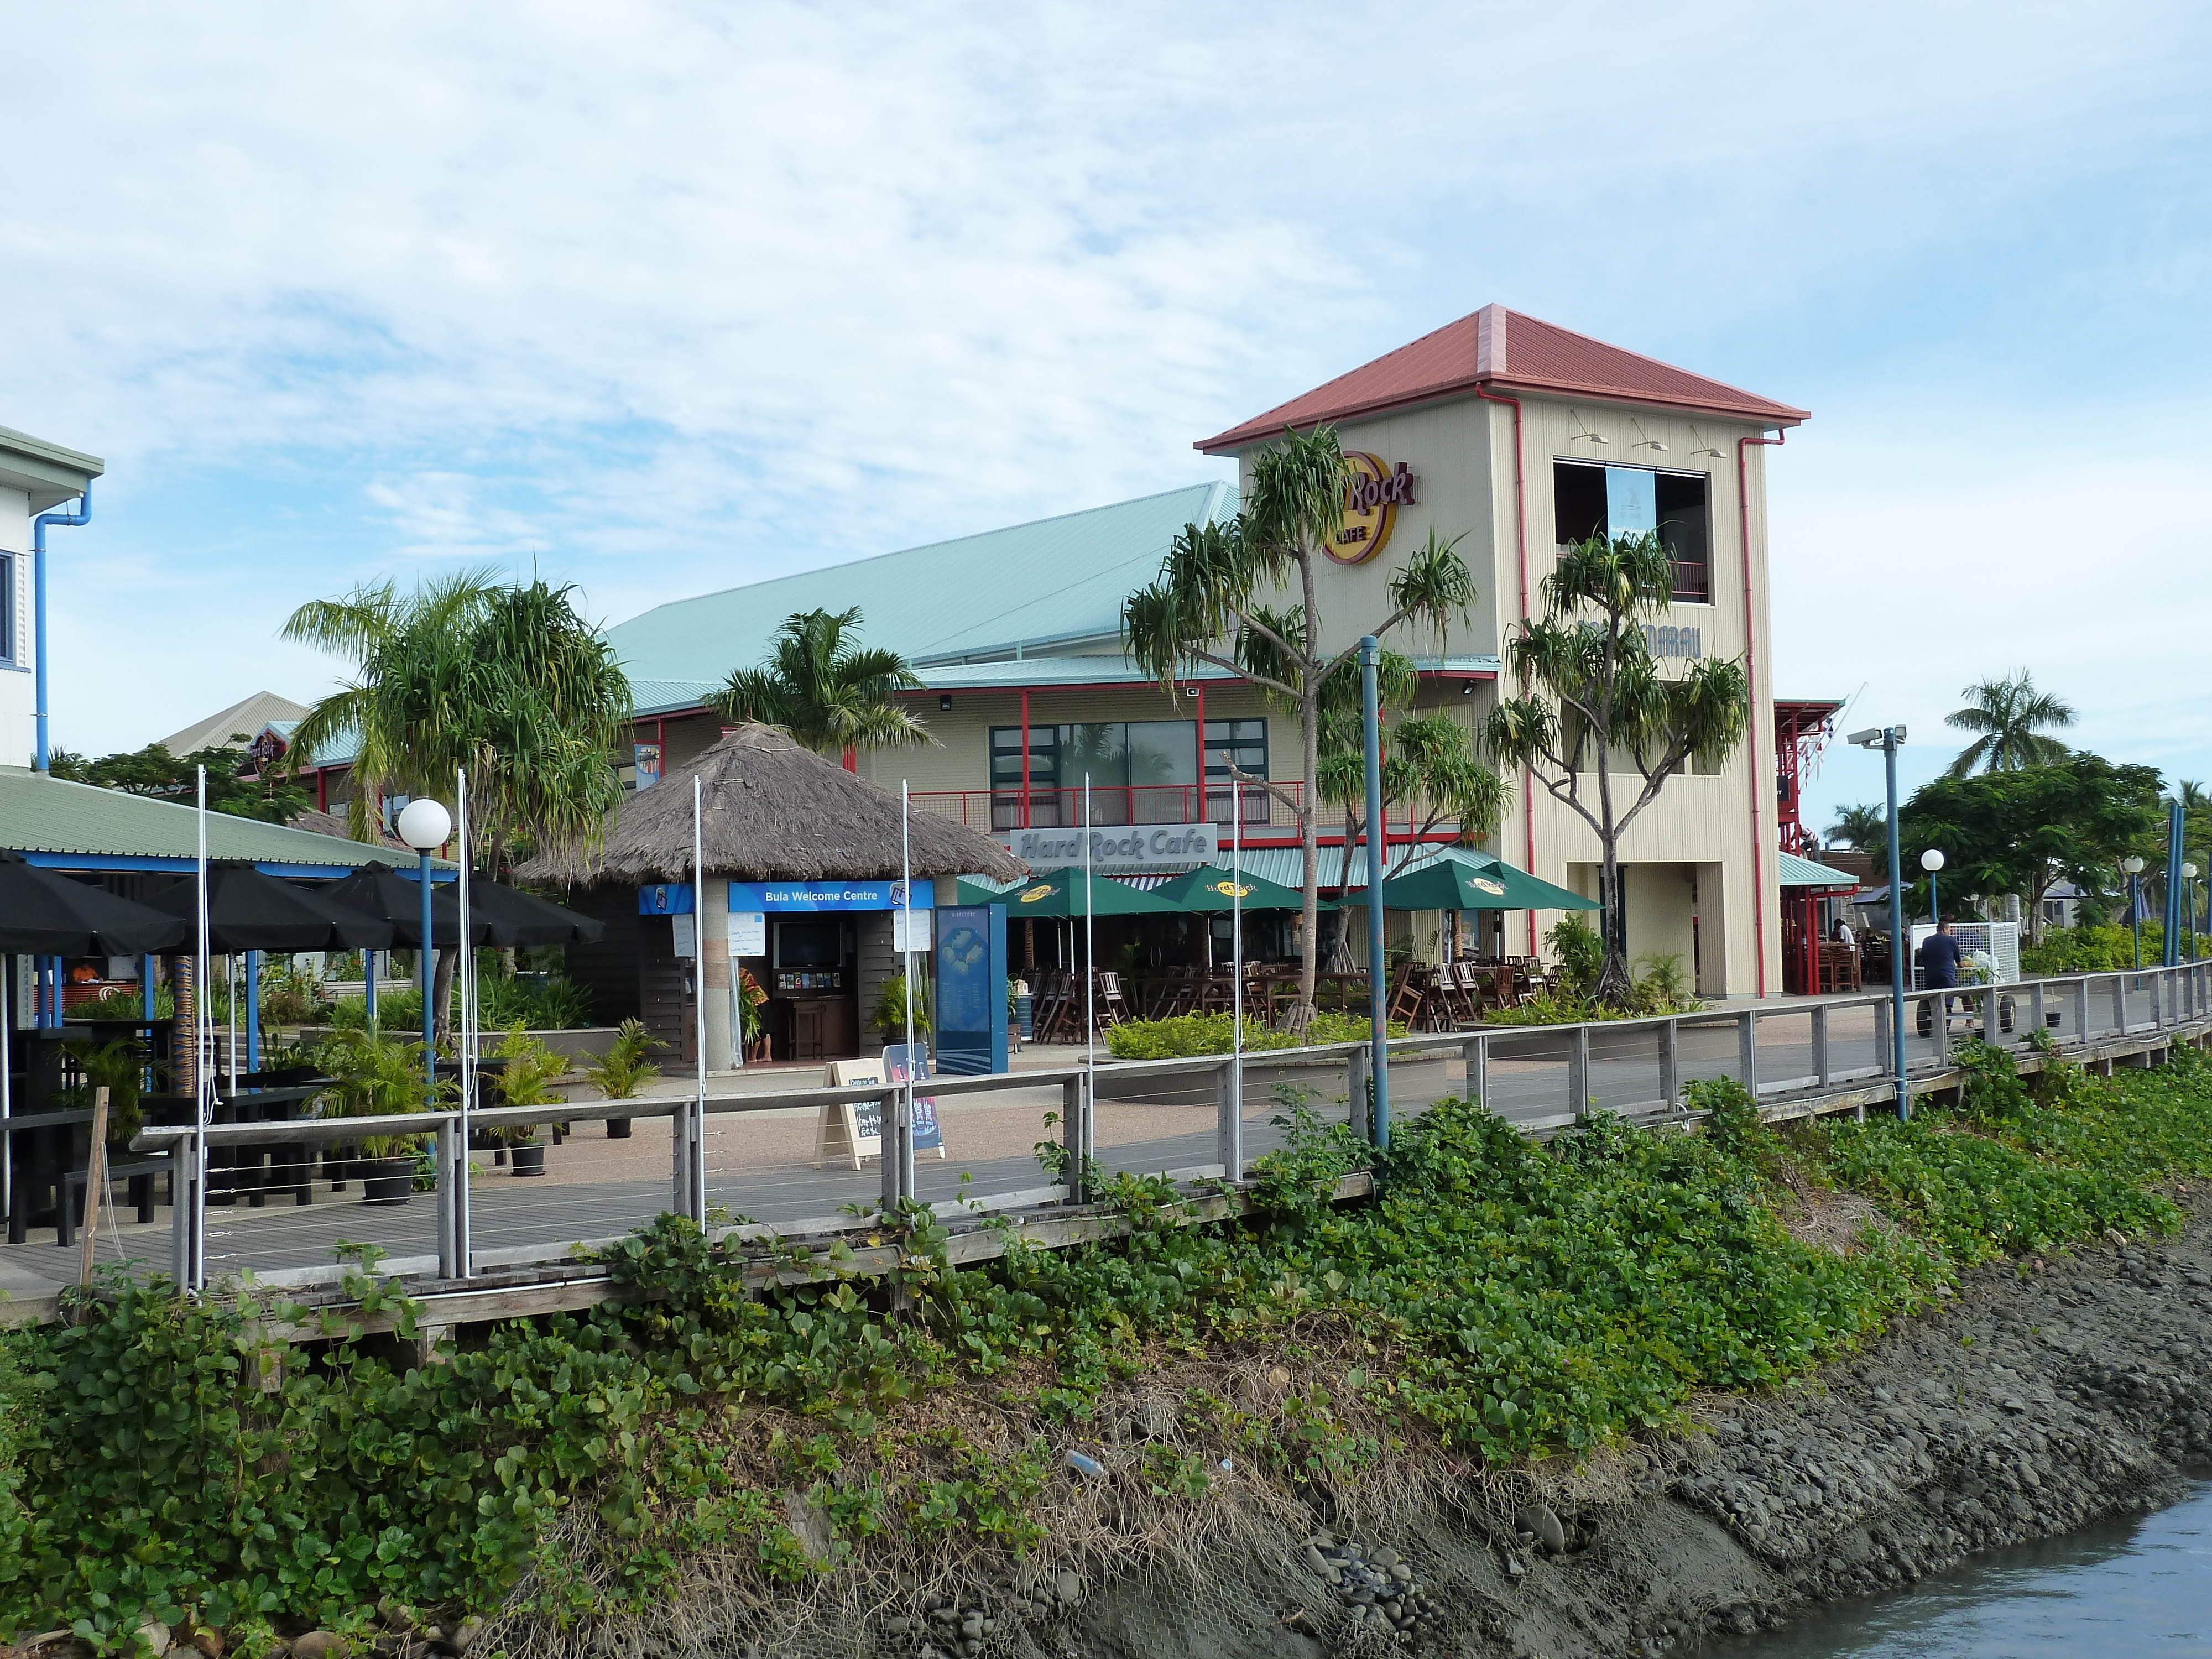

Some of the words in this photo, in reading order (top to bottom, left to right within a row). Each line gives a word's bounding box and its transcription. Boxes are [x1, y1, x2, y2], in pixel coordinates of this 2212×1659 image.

[1348, 462, 1415, 515] Rock
[1020, 832, 1083, 858] Hard
[1087, 831, 1145, 862] Rock
[1150, 828, 1207, 855] Cafe
[765, 891, 789, 901] Bula
[792, 890, 841, 901] Welcome
[843, 890, 878, 901] Centre
